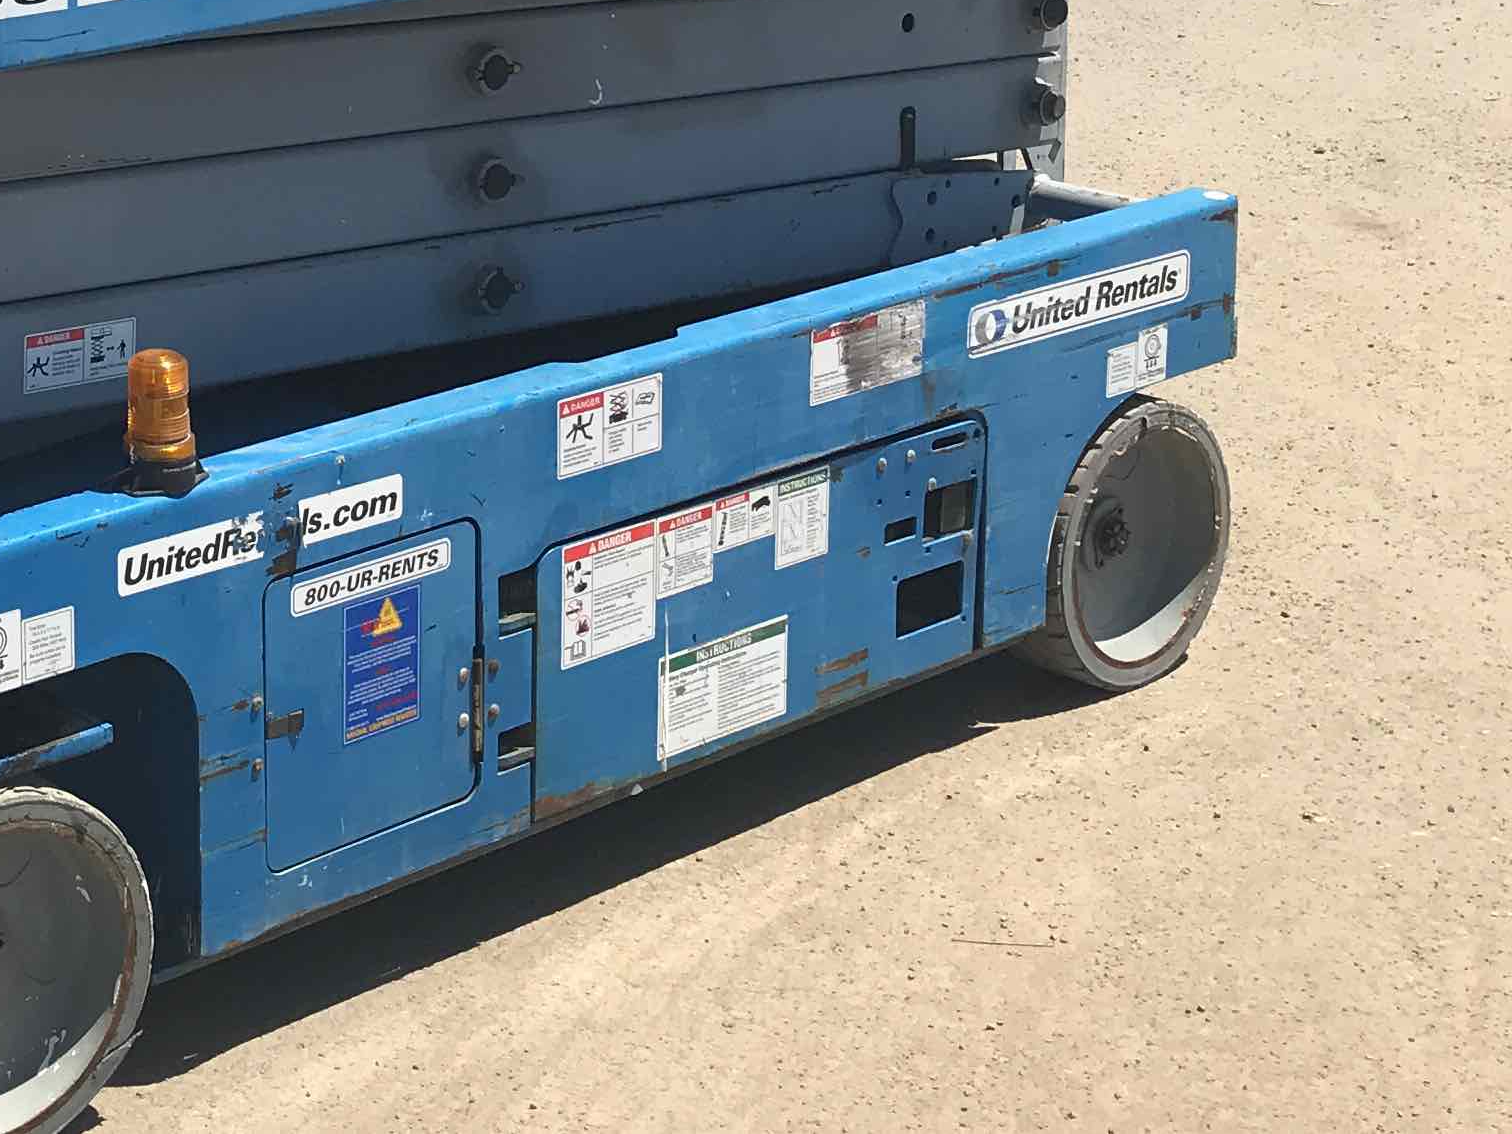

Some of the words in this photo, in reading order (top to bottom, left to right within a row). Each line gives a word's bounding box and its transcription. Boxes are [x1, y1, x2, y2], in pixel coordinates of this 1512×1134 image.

[1011, 286, 1091, 334] United
[1094, 265, 1178, 312] Rentals
[570, 396, 601, 411] DANGER
[676, 511, 702, 527] DANGER
[123, 491, 398, 586] UnitedRels.com
[597, 531, 632, 552] DANGER
[304, 548, 439, 606] 800-UR-RENTS
[696, 634, 752, 662] INSTRUCTIONS
